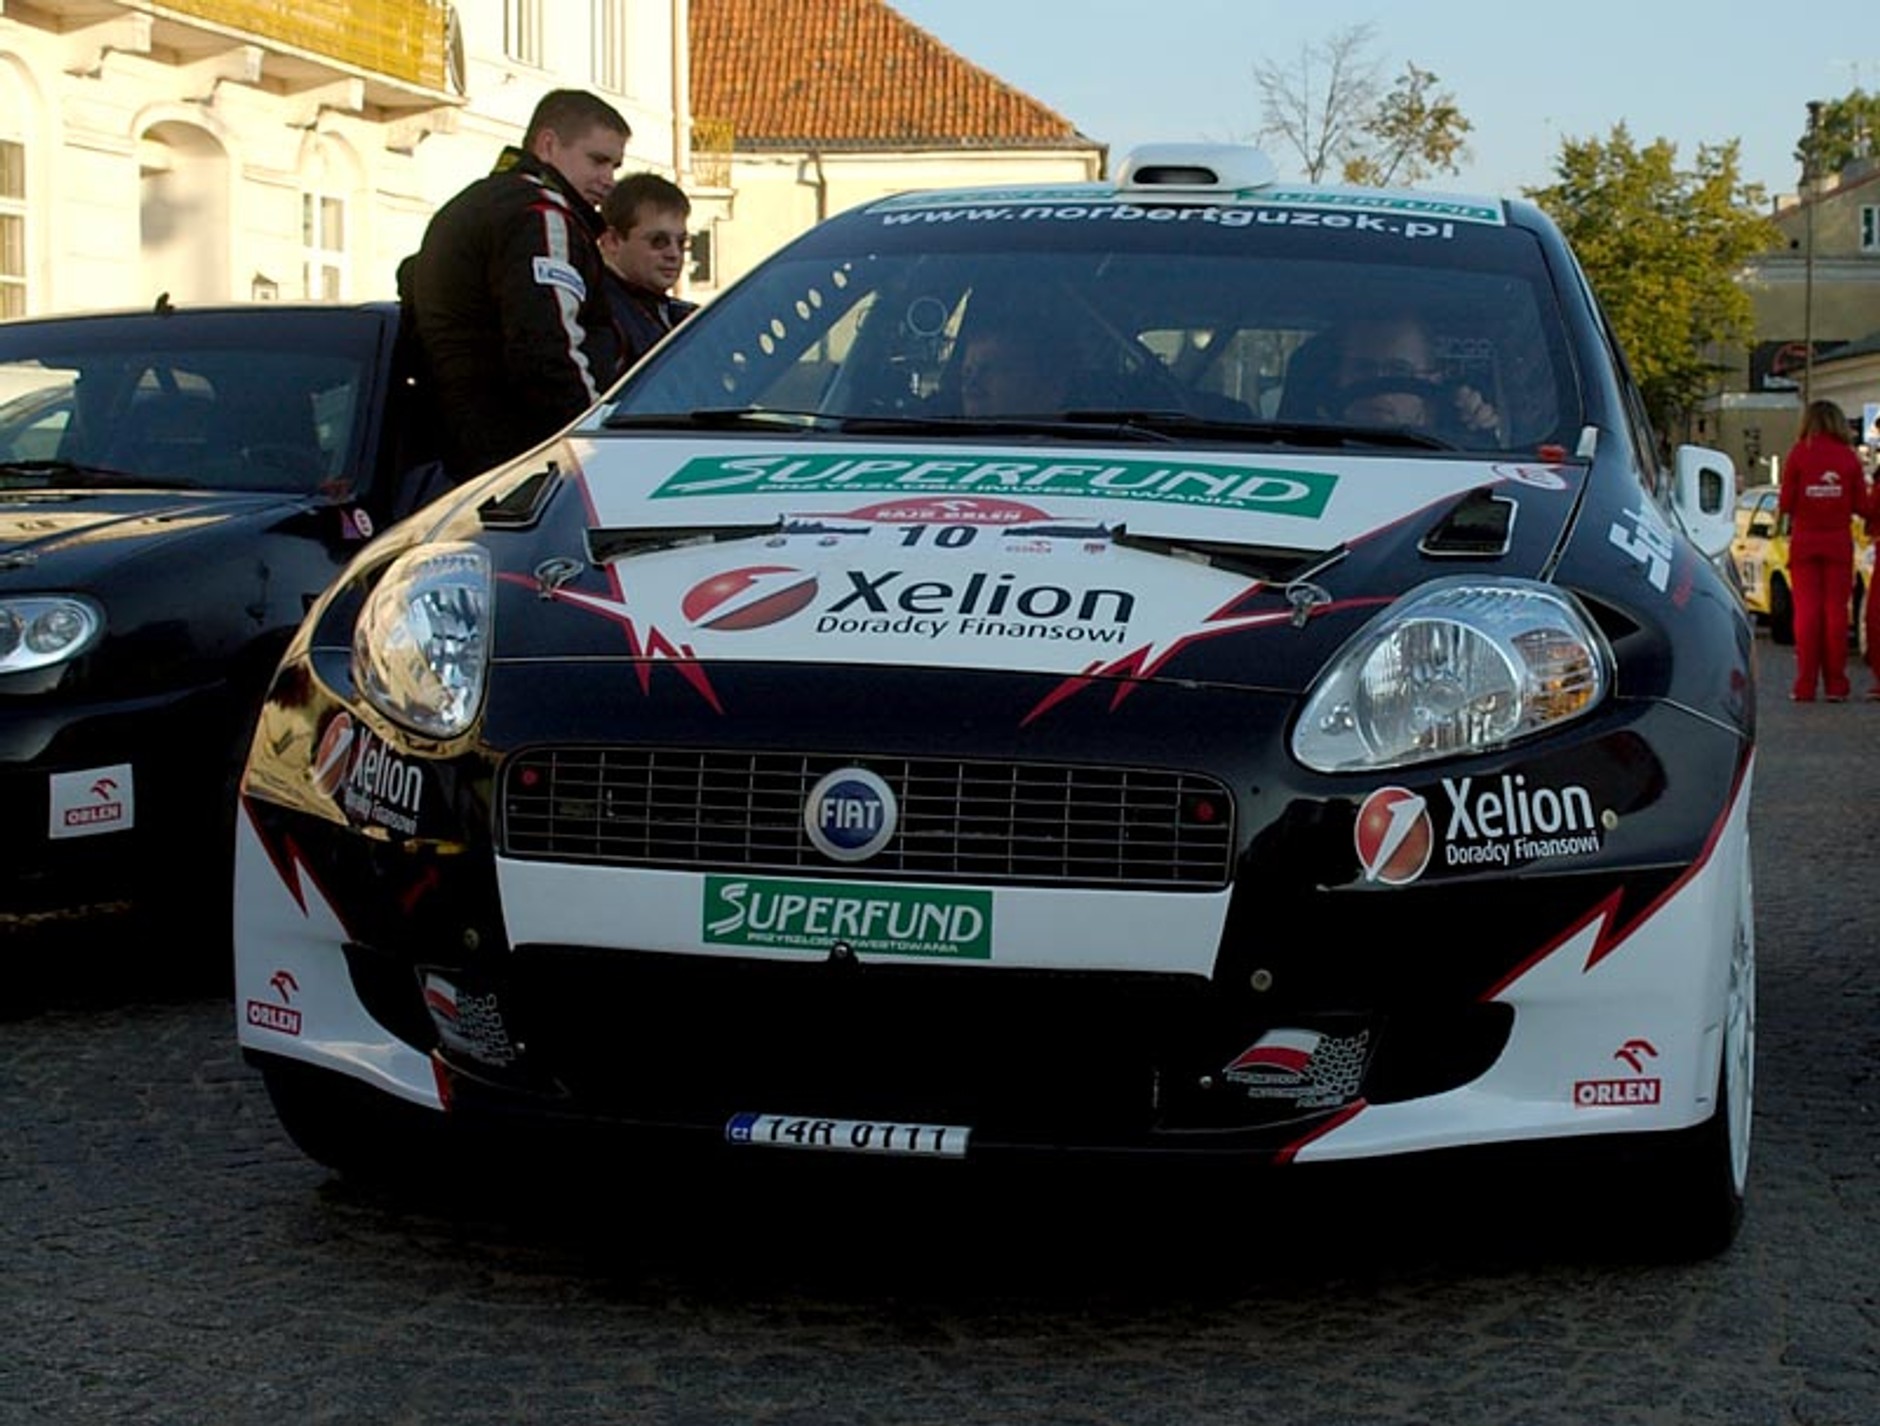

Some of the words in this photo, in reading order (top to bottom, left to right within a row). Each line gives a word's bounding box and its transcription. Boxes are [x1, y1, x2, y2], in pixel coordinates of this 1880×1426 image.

[664, 457, 1312, 502] SUPERFUND
[898, 524, 978, 550] 10
[826, 570, 1135, 623] Xelion
[816, 616, 950, 638] Doradcy
[959, 618, 1127, 644] Finansowi
[350, 726, 422, 812] Xelion
[68, 806, 119, 824] ORLEN
[820, 798, 880, 829] FIAT
[1441, 774, 1595, 840] Xelion
[1446, 838, 1510, 866] Doradcy
[1515, 830, 1600, 860] Finansowi
[707, 882, 983, 942] SUPERFUND
[249, 1003, 299, 1033] ORLEN
[1579, 1082, 1656, 1104] ORLEN
